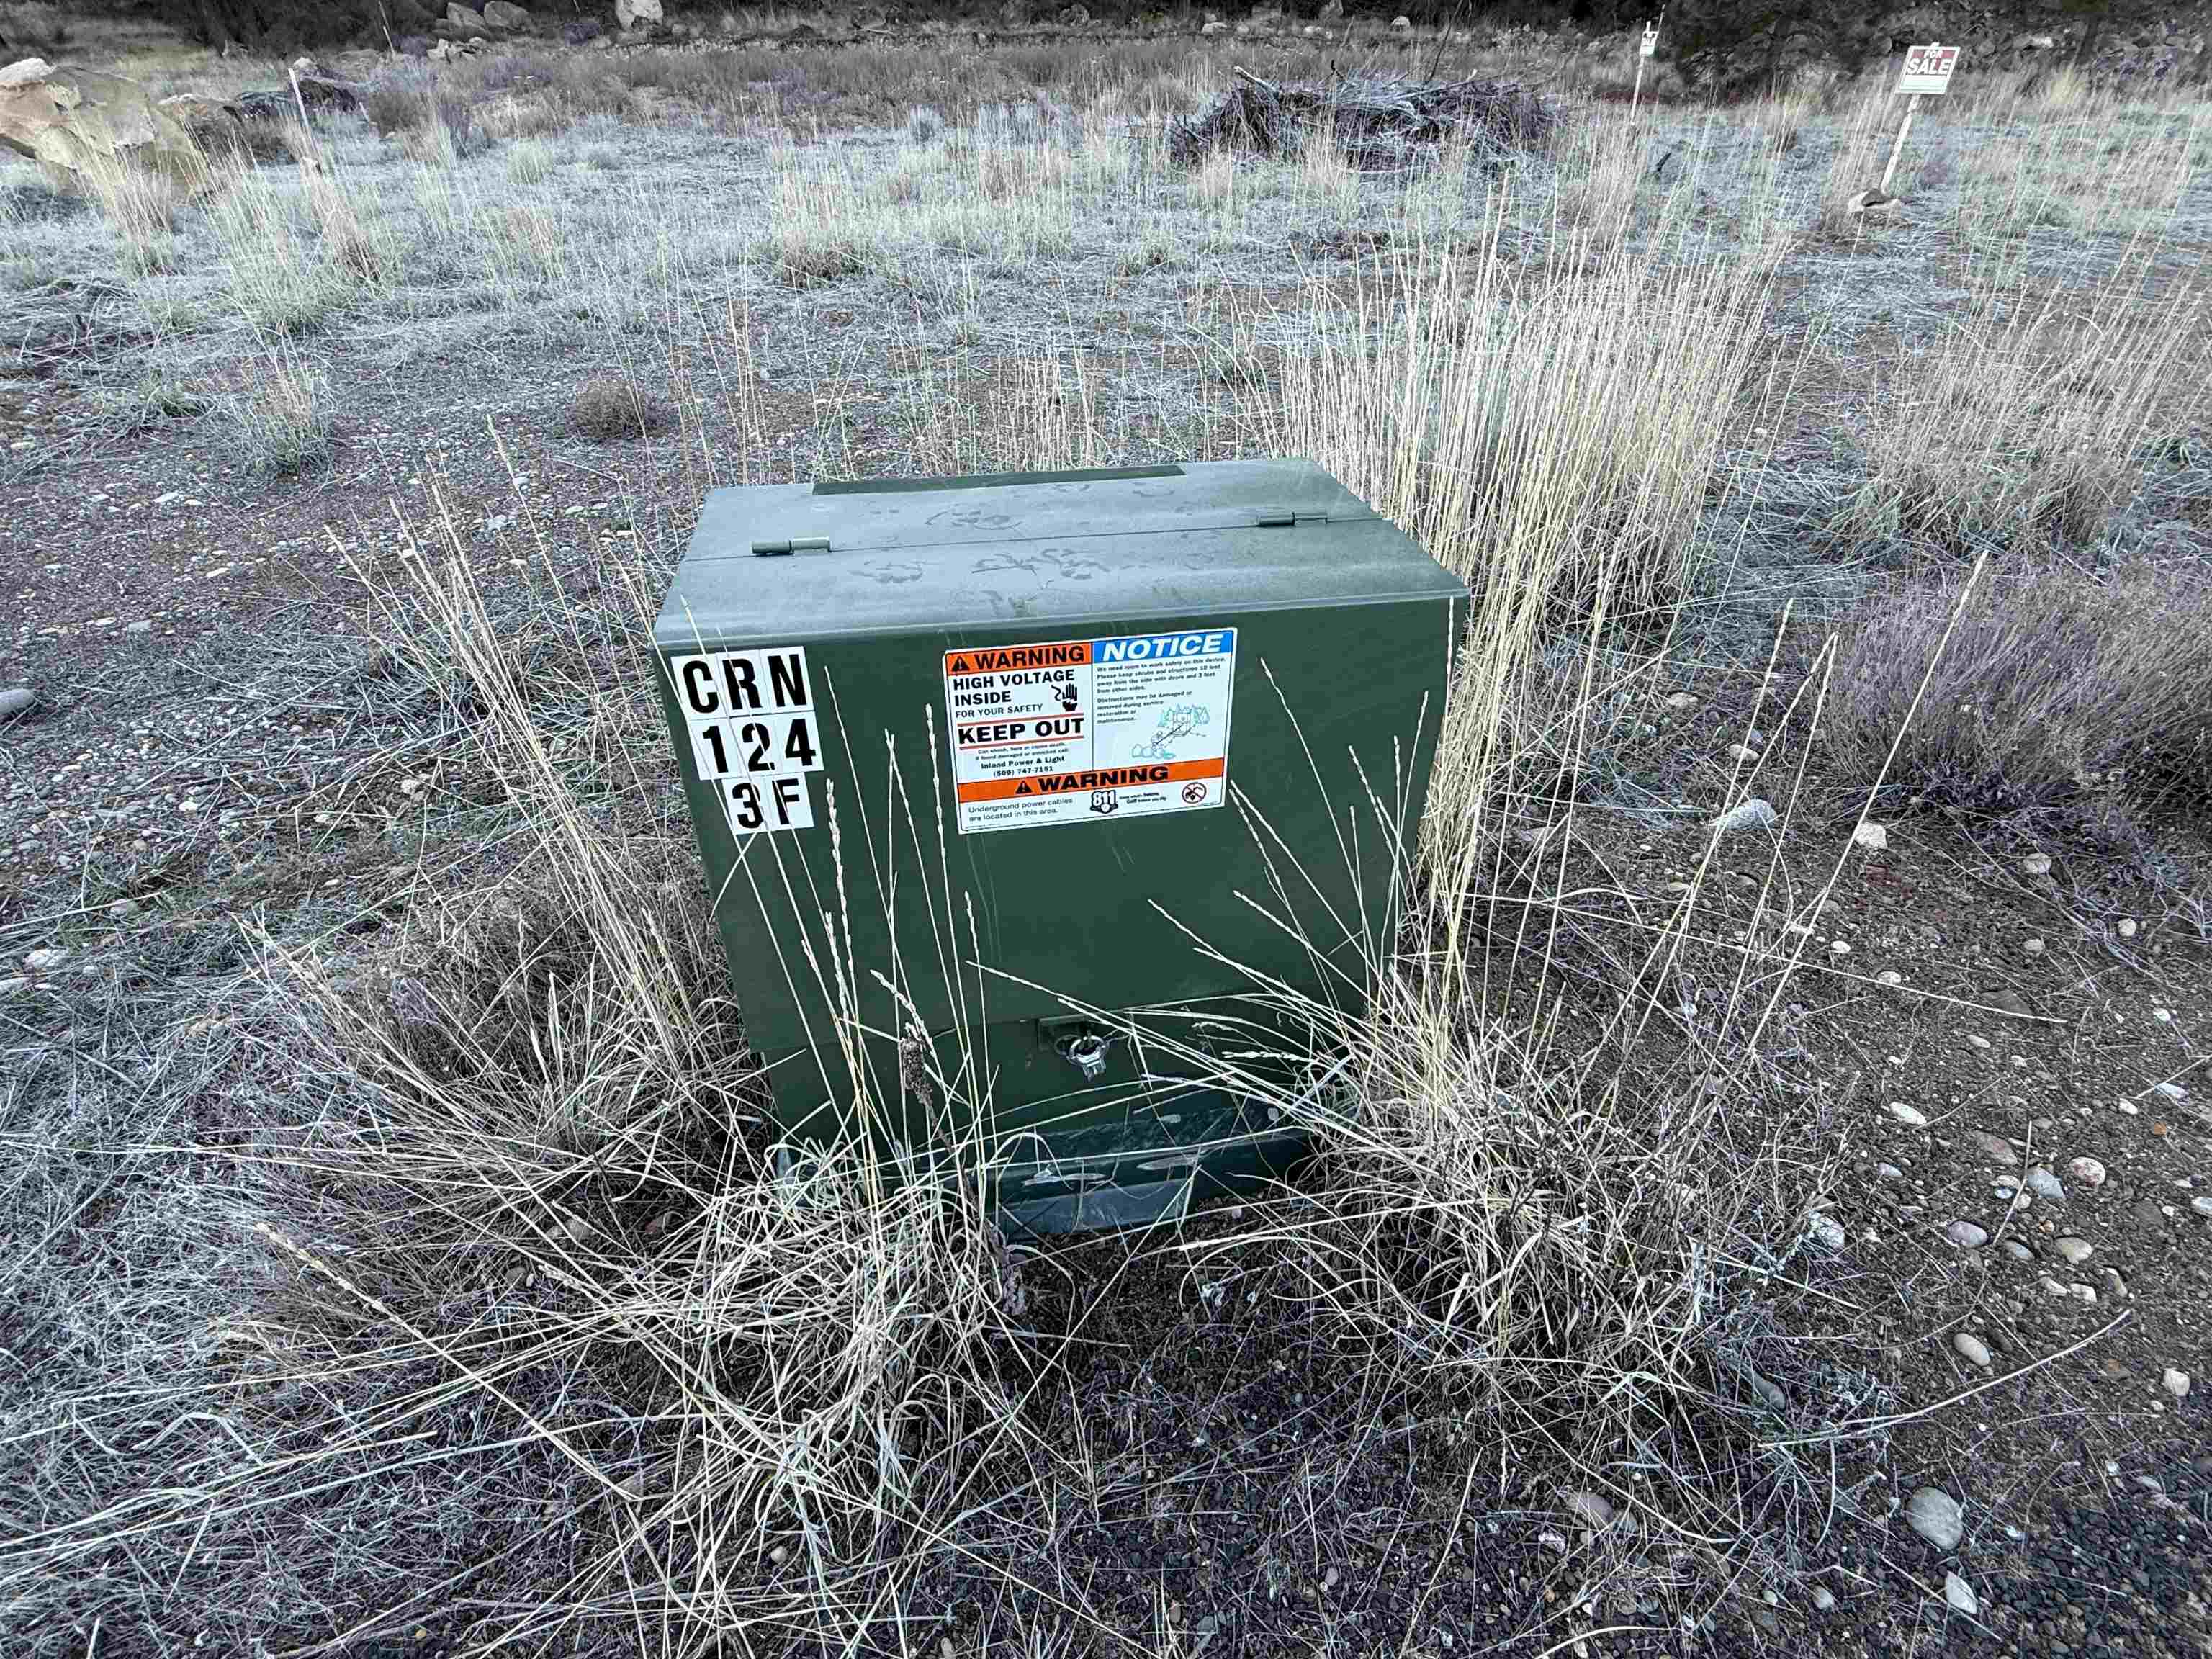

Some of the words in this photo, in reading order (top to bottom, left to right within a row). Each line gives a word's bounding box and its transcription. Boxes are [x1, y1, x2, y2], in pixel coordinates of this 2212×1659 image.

[1923, 50, 1943, 58] FOR
[1907, 58, 1952, 75] SALE
[1103, 634, 1223, 661] NOTICE
[974, 646, 1084, 670] WARNING
[683, 654, 807, 714] CRN
[953, 676, 994, 690] HIGH
[1000, 670, 1074, 686] VOLTAGE
[955, 691, 1012, 706] INSIDE
[956, 710, 974, 719] FOR
[979, 707, 1004, 716] YOUR
[1008, 703, 1043, 714] SAFETY
[958, 724, 1025, 745] KEEP
[1035, 718, 1084, 737] OUT
[702, 719, 817, 773] 124
[981, 760, 1006, 769] Inland
[1045, 756, 1065, 765] Light
[993, 769, 1015, 778] (509)
[1017, 765, 1053, 775] 747-7151
[1038, 766, 1169, 792] WARNING
[732, 778, 800, 829] 3F
[1092, 790, 1116, 806] 811
[968, 802, 1020, 814] Underground
[1021, 800, 1046, 809] power
[984, 811, 1012, 820] located
